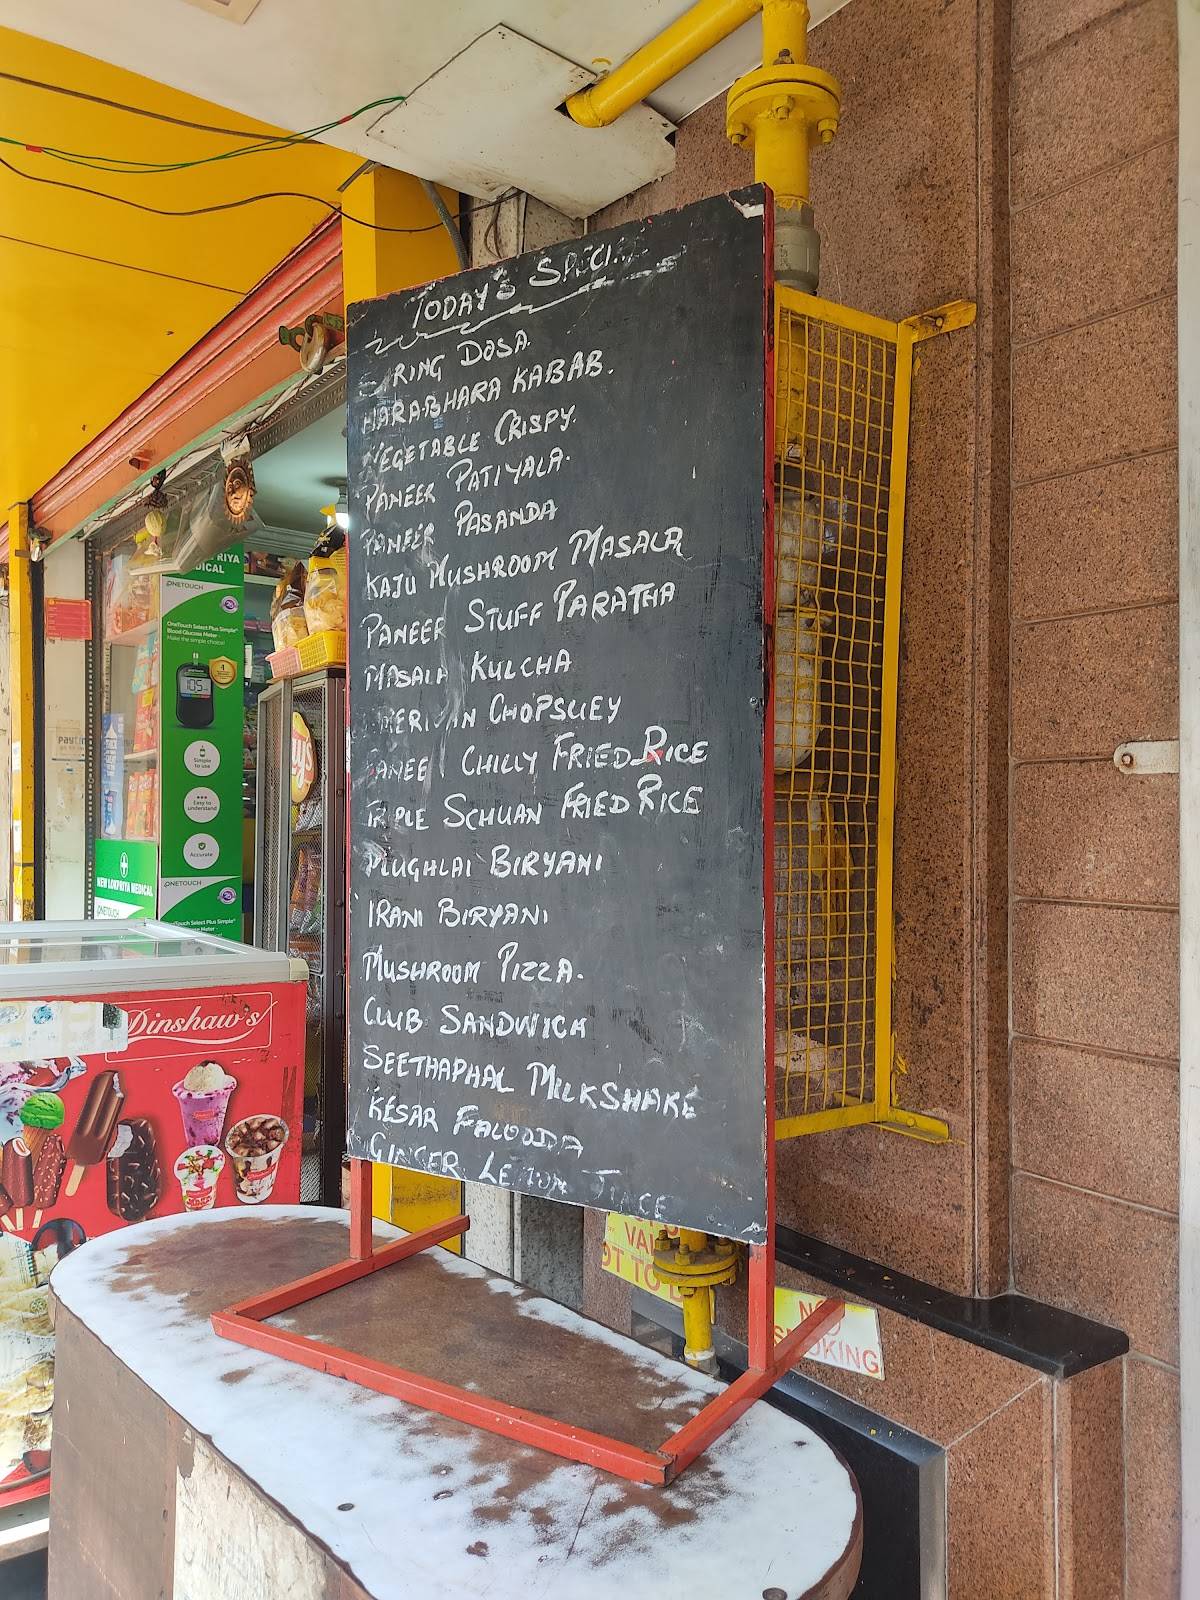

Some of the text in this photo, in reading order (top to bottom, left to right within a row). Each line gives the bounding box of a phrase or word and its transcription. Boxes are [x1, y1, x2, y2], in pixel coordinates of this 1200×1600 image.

[512, 349, 615, 393] KABAB.
[494, 405, 577, 446] CRISPY.
[359, 446, 571, 516] PANEER PATIYALA.
[360, 499, 558, 556] PANEER PASANDA
[365, 524, 687, 600] KAJU MUSHROOM MASALA
[361, 578, 677, 649] PANEER STUFF PARATHA
[364, 649, 573, 692] MASALA KULCHA
[489, 692, 622, 725] CHOPSUEY
[461, 745, 539, 776] CHILLY
[552, 731, 632, 771] FRIED
[631, 725, 710, 766] RICE
[442, 792, 543, 831] SCHUAN
[560, 782, 631, 818] FRIED
[637, 773, 704, 815] RICE
[489, 844, 603, 878] BIRYANI
[368, 897, 549, 929] IRANI BIRYANI
[362, 941, 585, 985] MUSHROOM PIZZA.
[128, 1001, 277, 1036] Dinshaw's
[363, 995, 424, 1034] CLUB
[362, 1044, 699, 1120] SEETHAPHAL MILKSHAKE
